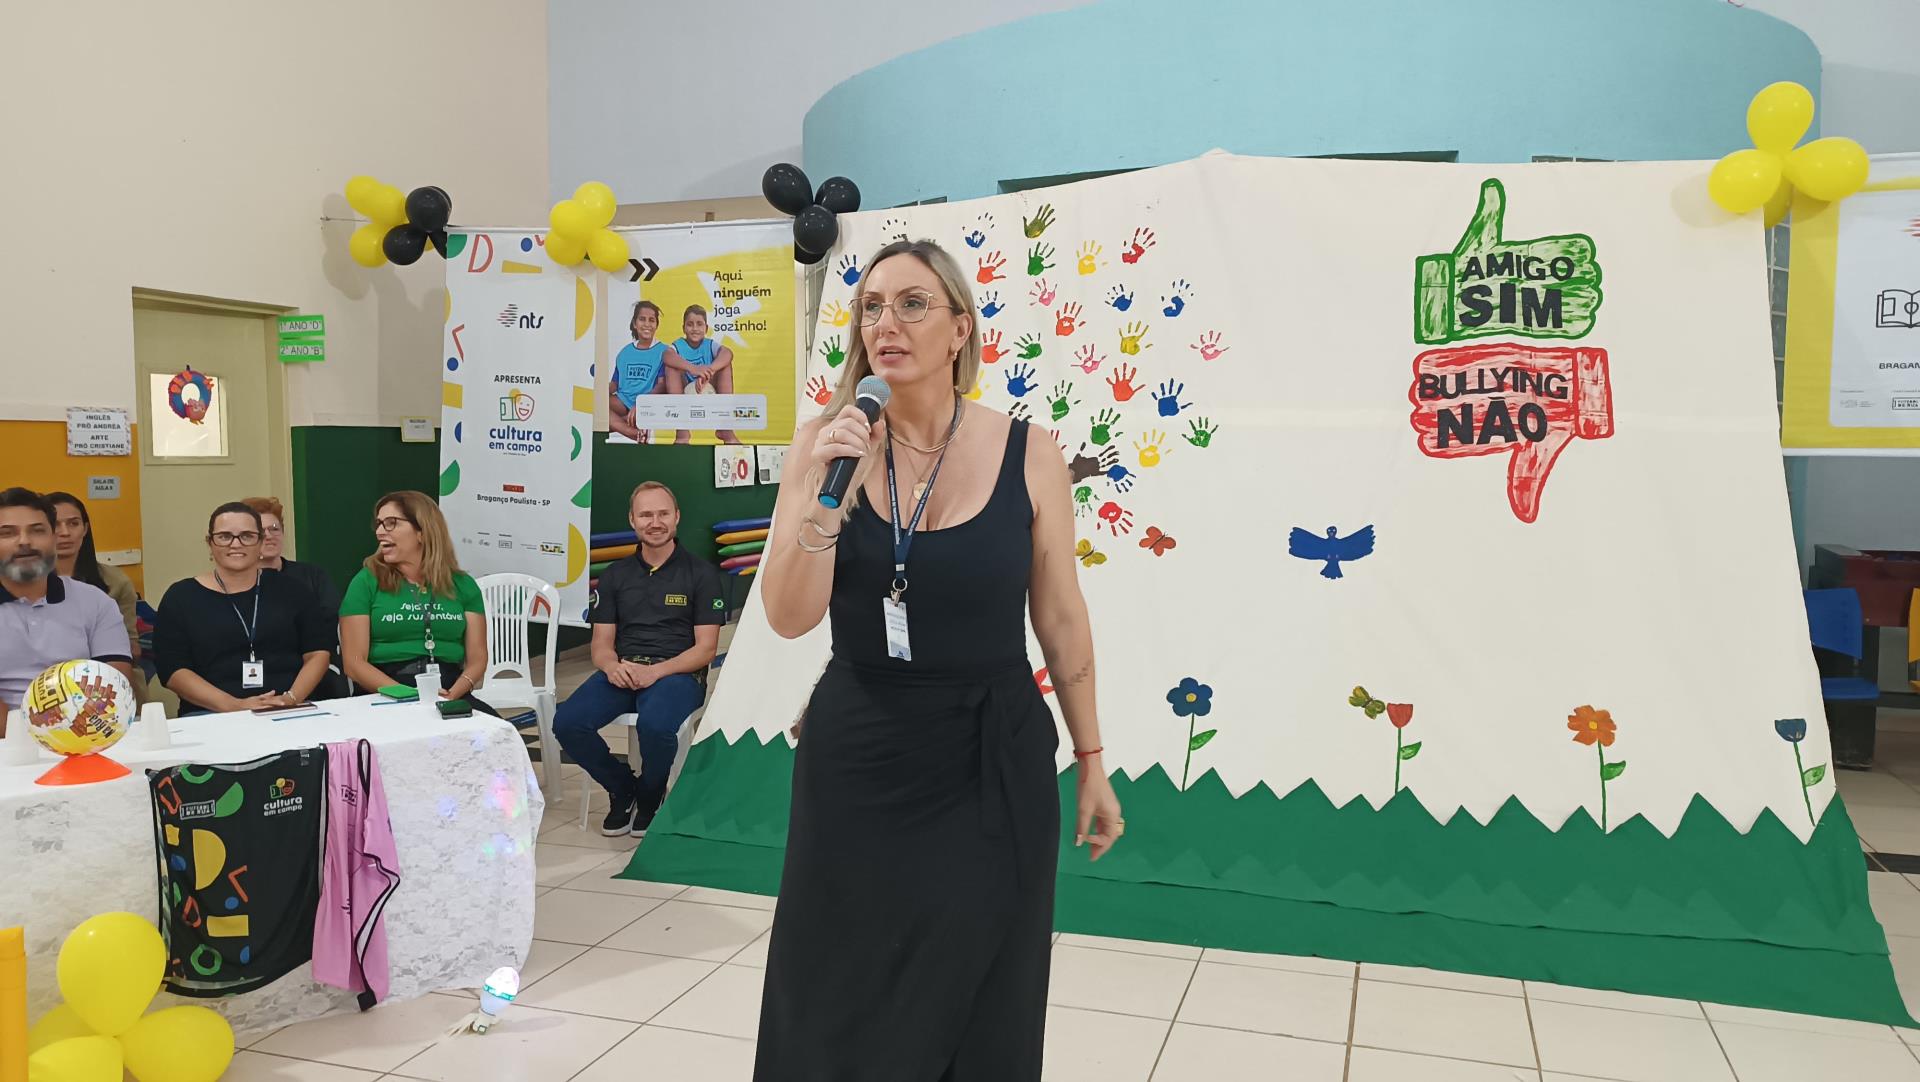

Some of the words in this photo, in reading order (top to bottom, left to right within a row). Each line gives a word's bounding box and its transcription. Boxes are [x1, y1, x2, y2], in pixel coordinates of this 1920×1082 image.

[1462, 252, 1575, 281] AMIGO
[713, 269, 744, 284] Aqui
[713, 285, 772, 301] ninguém
[713, 304, 741, 318] joga
[1459, 282, 1563, 329] SIM
[289, 321, 308, 331] ANO
[519, 311, 544, 329] nts
[713, 319, 768, 332] sozinho!
[290, 345, 309, 355] ANO
[493, 373, 542, 385] APRESENTA
[1418, 367, 1568, 400] BULLYING
[1436, 396, 1548, 448] NÃO
[488, 424, 543, 442] cultura
[488, 441, 505, 451] em
[506, 441, 543, 454] campo
[476, 493, 509, 505] Bragança
[509, 496, 537, 506] Paulista
[542, 499, 551, 507] SP
[381, 613, 403, 624] seja
[263, 796, 304, 811] cultura
[263, 809, 277, 817] em
[277, 804, 304, 815] campo
